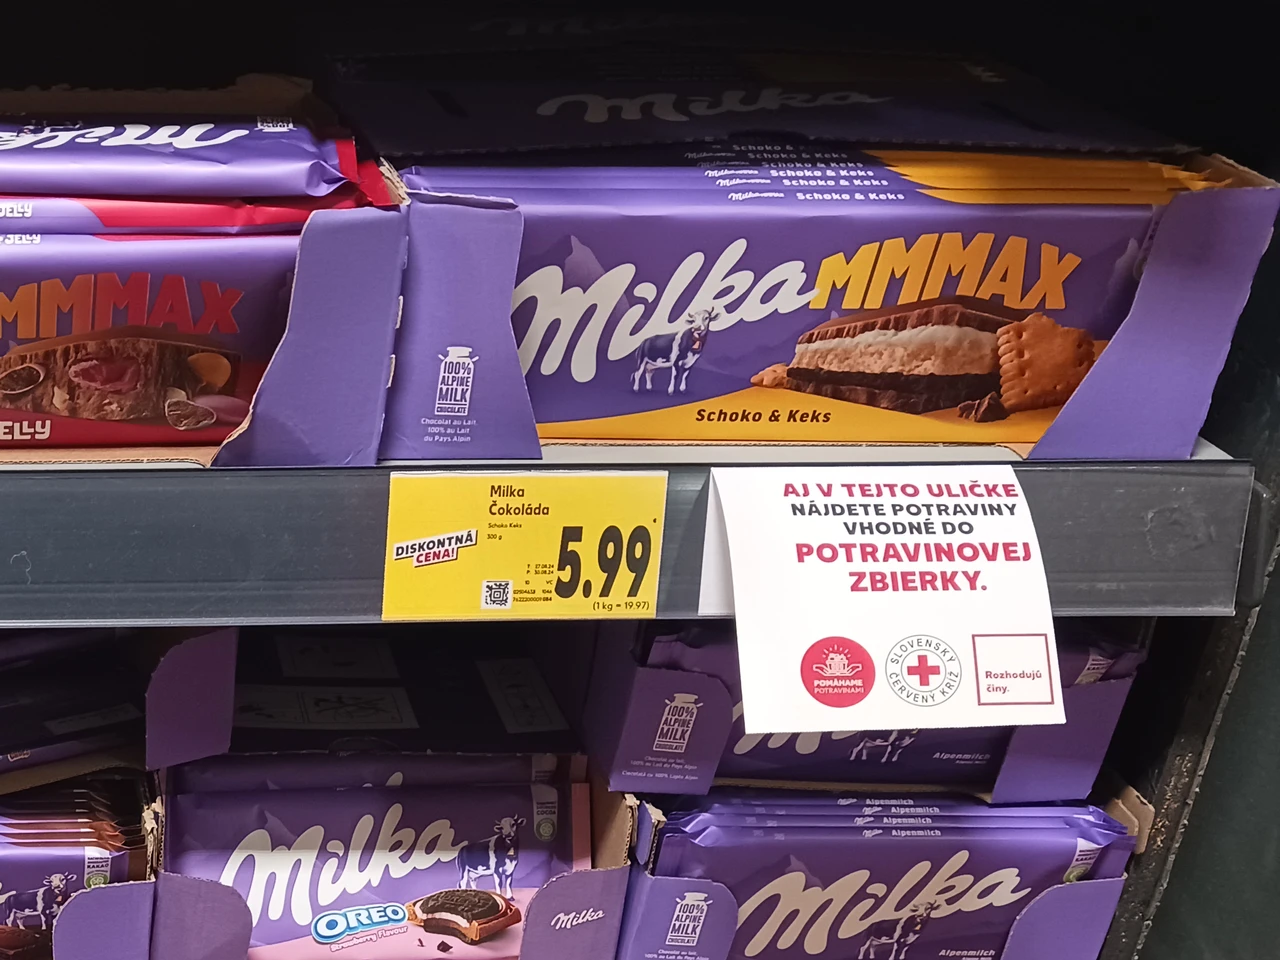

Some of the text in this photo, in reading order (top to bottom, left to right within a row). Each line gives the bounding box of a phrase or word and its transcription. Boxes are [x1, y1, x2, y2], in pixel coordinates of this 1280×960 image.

[510, 232, 1082, 383] Milka MMMAX
[695, 409, 832, 423] Schoko & Keks
[490, 485, 525, 498] Milka
[783, 480, 1019, 498] AJ V TEJTO ULIČKE
[489, 501, 550, 516] Čokoláda
[791, 500, 1017, 516] NÁJDETE POTRAVINY
[843, 518, 974, 535] VHODNÉ DO
[395, 530, 474, 557] DISKONTNÁ
[795, 542, 1032, 563] POTRAVINOVEJ
[416, 548, 455, 564] CENA!
[554, 525, 652, 598] 5.99
[848, 570, 988, 592] ZBIERKY.
[888, 670, 937, 704] ČERVENÝ
[986, 683, 1010, 694] činy.
[220, 803, 469, 927] Milka
[736, 850, 1031, 957] Milka
[316, 904, 404, 940] OREO
[550, 908, 606, 930] Milka
[330, 925, 408, 952] Strawberry Flavour
[939, 949, 996, 957] Alpenmilch
